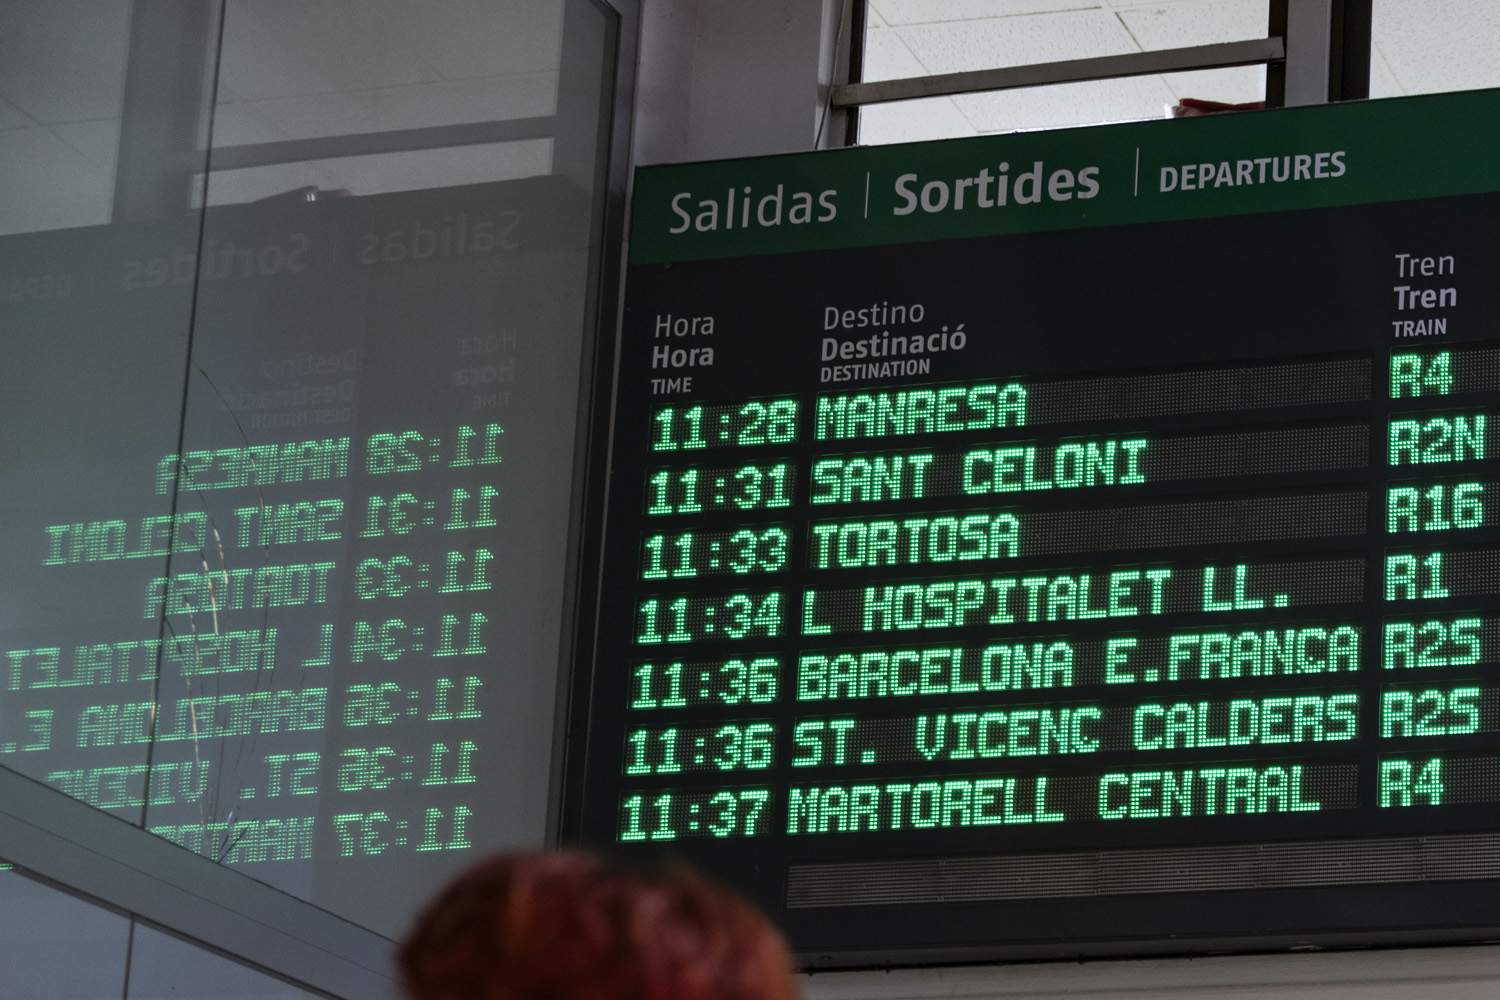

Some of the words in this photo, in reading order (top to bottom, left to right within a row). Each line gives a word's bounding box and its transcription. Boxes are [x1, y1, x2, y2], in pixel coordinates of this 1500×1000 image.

[669, 184, 838, 234] Salidas
[893, 160, 1100, 217] Sortides
[1158, 151, 1347, 194] DEPARTURES
[1395, 252, 1455, 278] Tren
[823, 300, 925, 331] Destino
[1393, 284, 1457, 311] Tren
[655, 313, 715, 339] Hora
[821, 324, 967, 362] Destinació
[1393, 318, 1447, 337] TRAIN
[651, 342, 715, 370] Hora
[820, 358, 930, 383] DESTINATION
[651, 377, 692, 396] TIME
[654, 400, 796, 450] 11:28
[816, 384, 1029, 439] MANRESA
[1390, 352, 1452, 398] R4
[649, 464, 790, 514] 11:31
[811, 454, 933, 503] SANT
[963, 439, 1148, 494] CELONI
[1388, 415, 1487, 465] R2N
[643, 528, 787, 578] 11:33
[813, 513, 1020, 568] TORTOSA
[1388, 483, 1483, 533] R16
[638, 592, 781, 643] 11:34
[801, 591, 831, 634] L
[863, 569, 1173, 631] HOSPITALET
[1202, 564, 1290, 611] LL.
[1386, 552, 1450, 600] R1
[632, 658, 778, 708] 11:36
[797, 642, 1073, 700] BARCELONA
[1105, 626, 1358, 684] E.FRANCA
[627, 724, 773, 774] 11:36
[792, 720, 875, 766] ST.
[916, 707, 1102, 760] VICENC
[1133, 694, 1358, 750] CALDERS
[621, 790, 768, 840] 11:37
[787, 777, 1064, 833] MARTORELL
[1099, 766, 1320, 819] CENTRAL
[1381, 758, 1444, 807] R4
